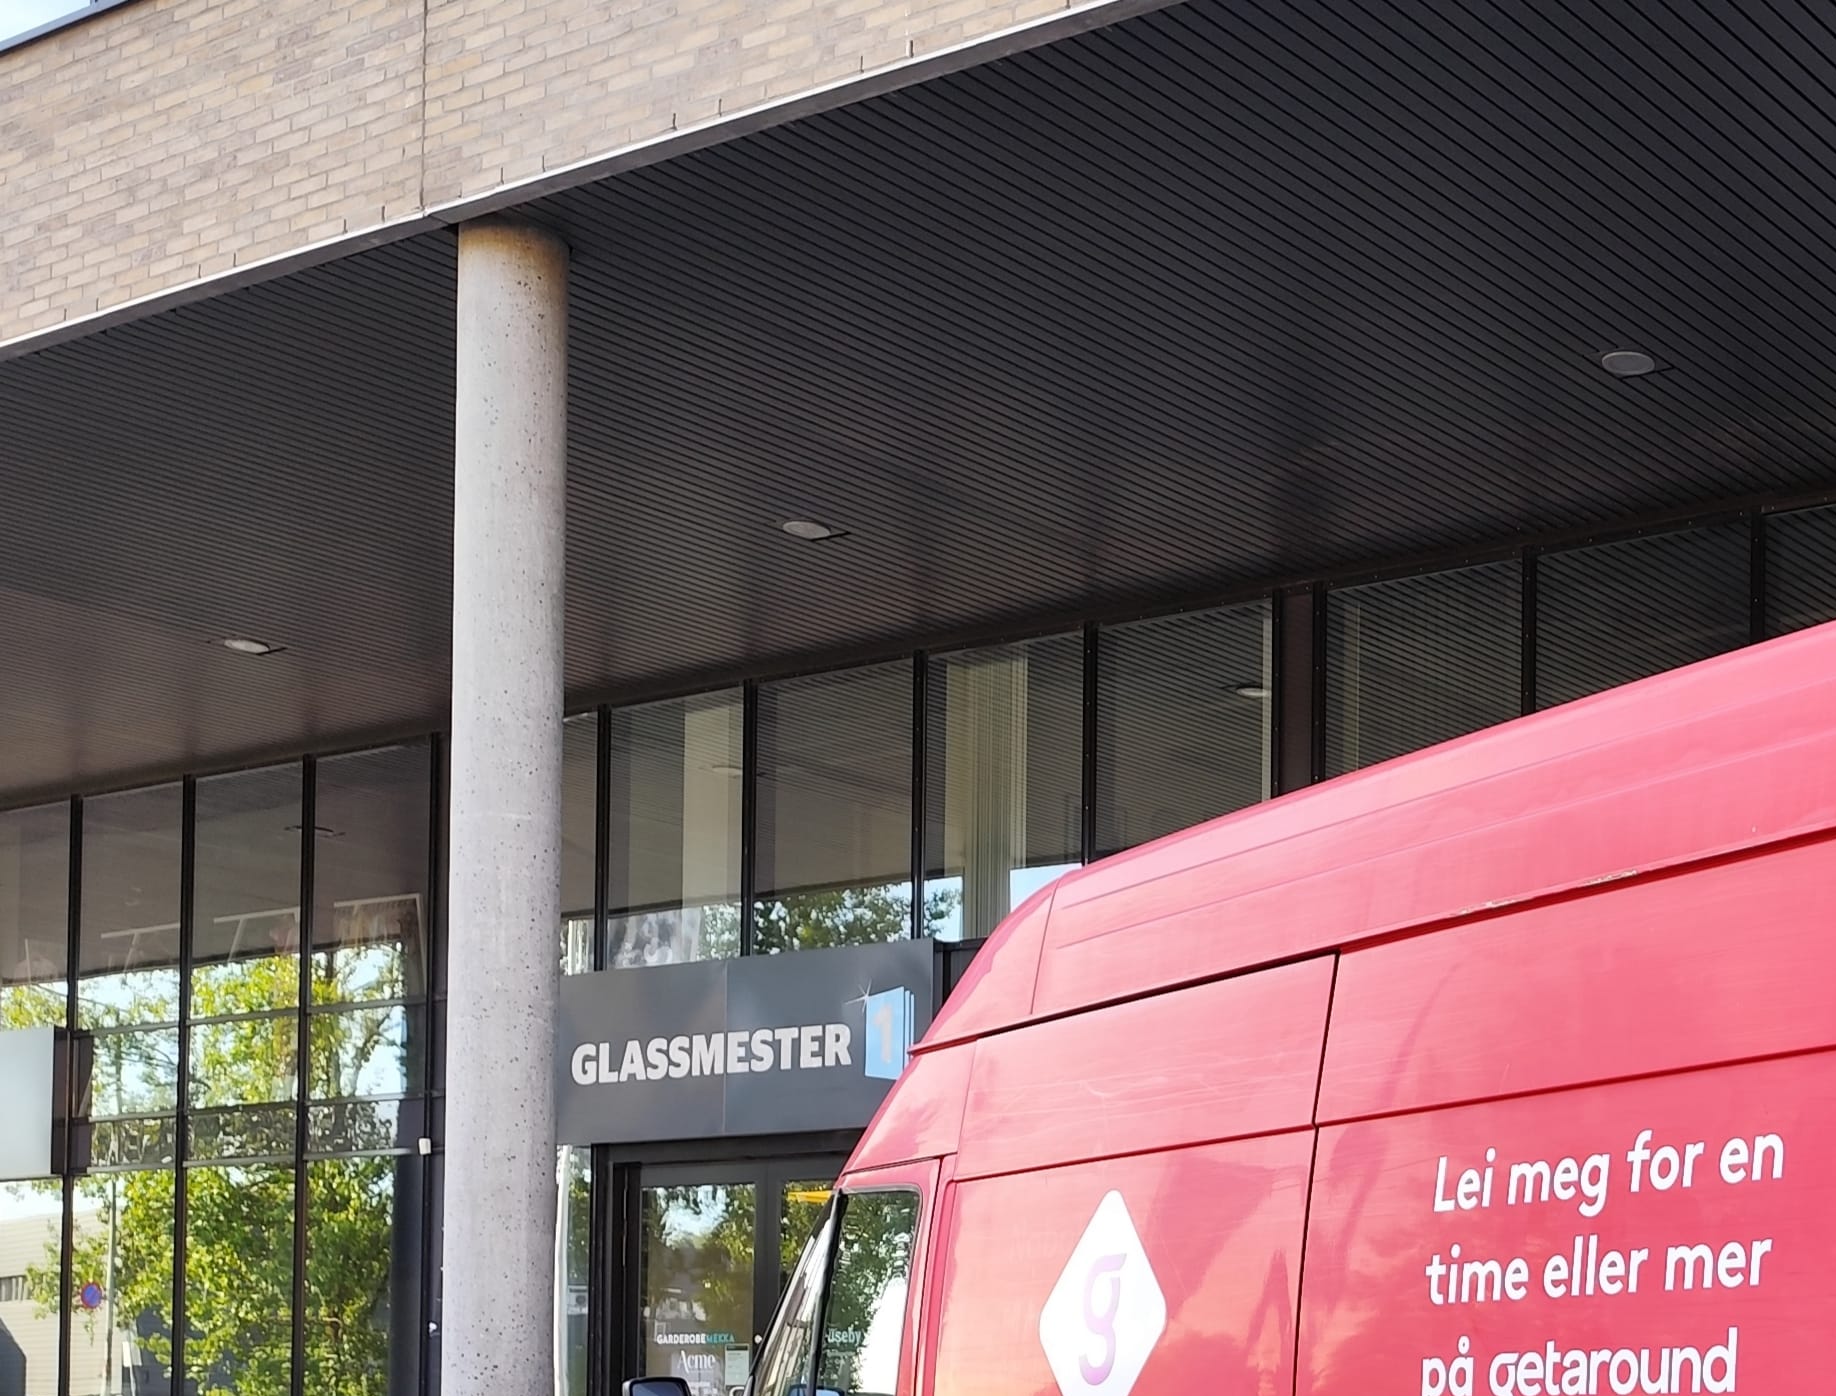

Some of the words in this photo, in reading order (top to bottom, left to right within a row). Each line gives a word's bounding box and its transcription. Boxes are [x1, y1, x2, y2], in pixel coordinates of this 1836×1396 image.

[571, 1023, 851, 1085] GLASSMESTER
[1433, 1148, 1495, 1213] Lei
[1507, 1152, 1610, 1217] meg
[1627, 1129, 1704, 1193] for
[1719, 1132, 1784, 1185] en
[1425, 1243, 1529, 1305] time
[1543, 1234, 1649, 1299] eller
[1664, 1238, 1773, 1292] mer
